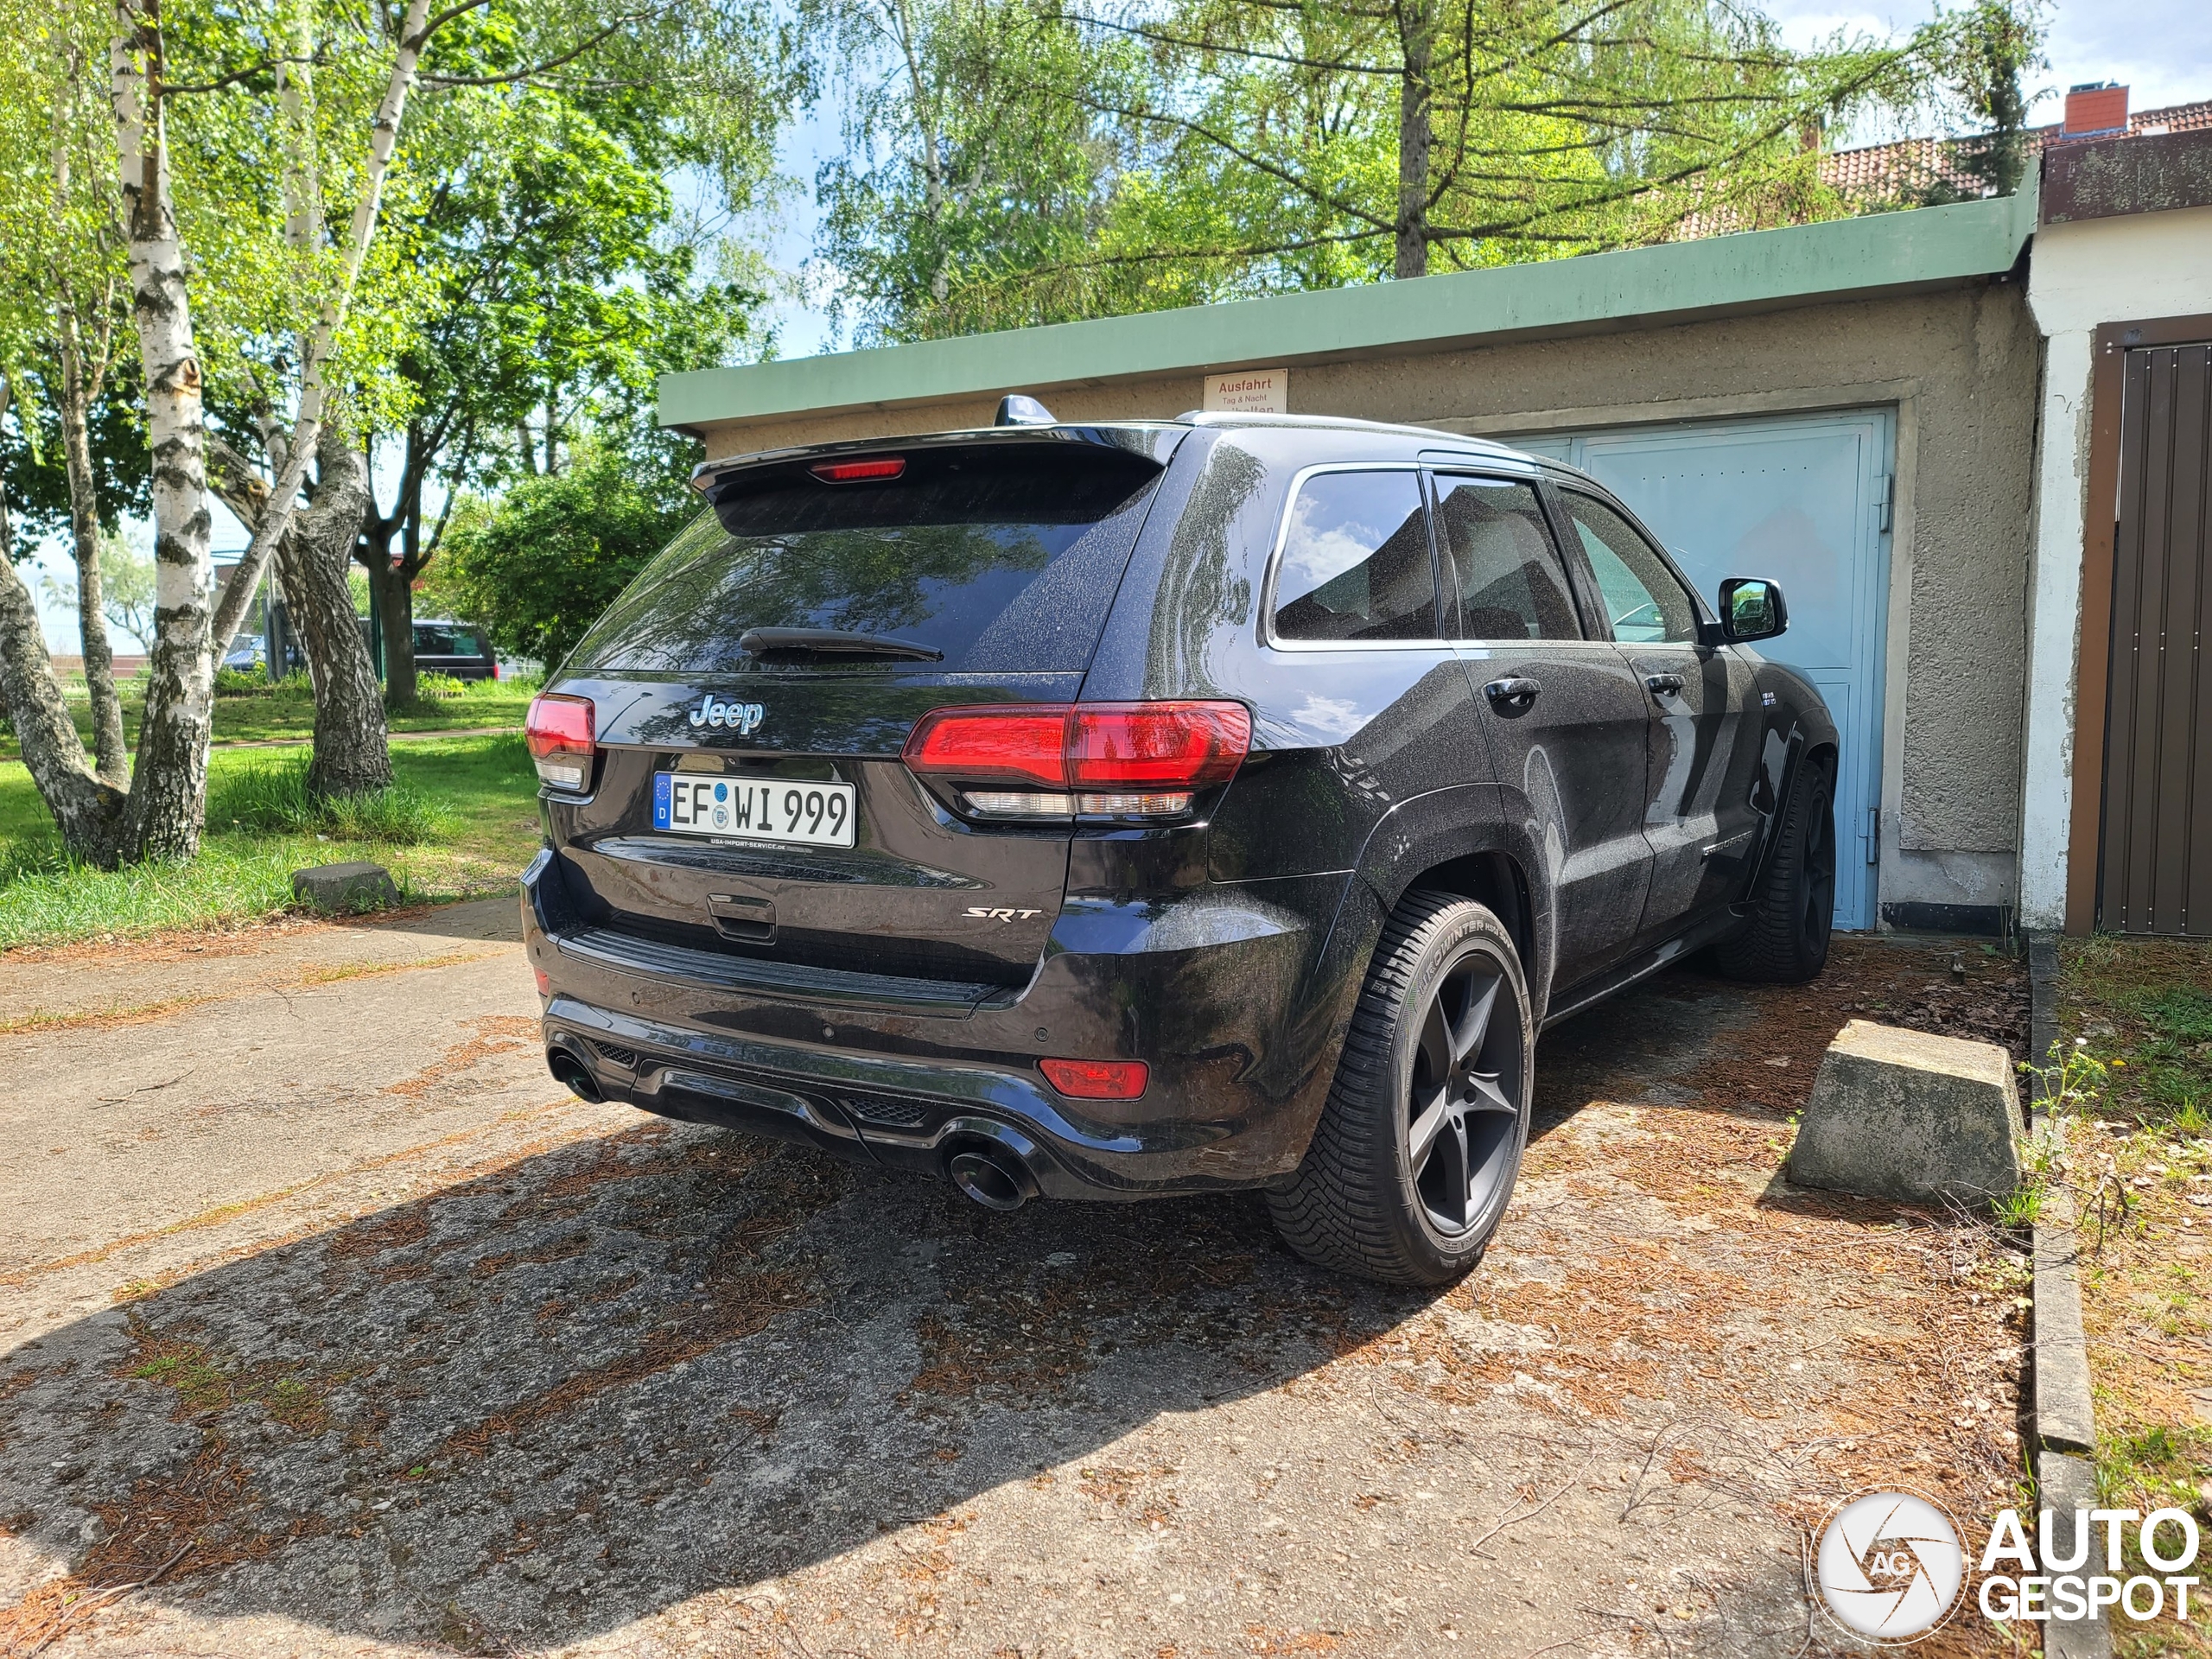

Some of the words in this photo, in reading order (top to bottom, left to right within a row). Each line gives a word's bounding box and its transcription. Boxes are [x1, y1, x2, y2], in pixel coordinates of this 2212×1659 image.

[689, 694, 764, 735] Jeep
[658, 807, 666, 820] D
[672, 781, 711, 824] EF
[734, 785, 772, 831] WI
[784, 790, 848, 836] 999
[961, 906, 1043, 924] SRT
[1218, 1242, 1272, 1258] Ausfahrt
[1244, 1258, 1268, 1267] Nacht
